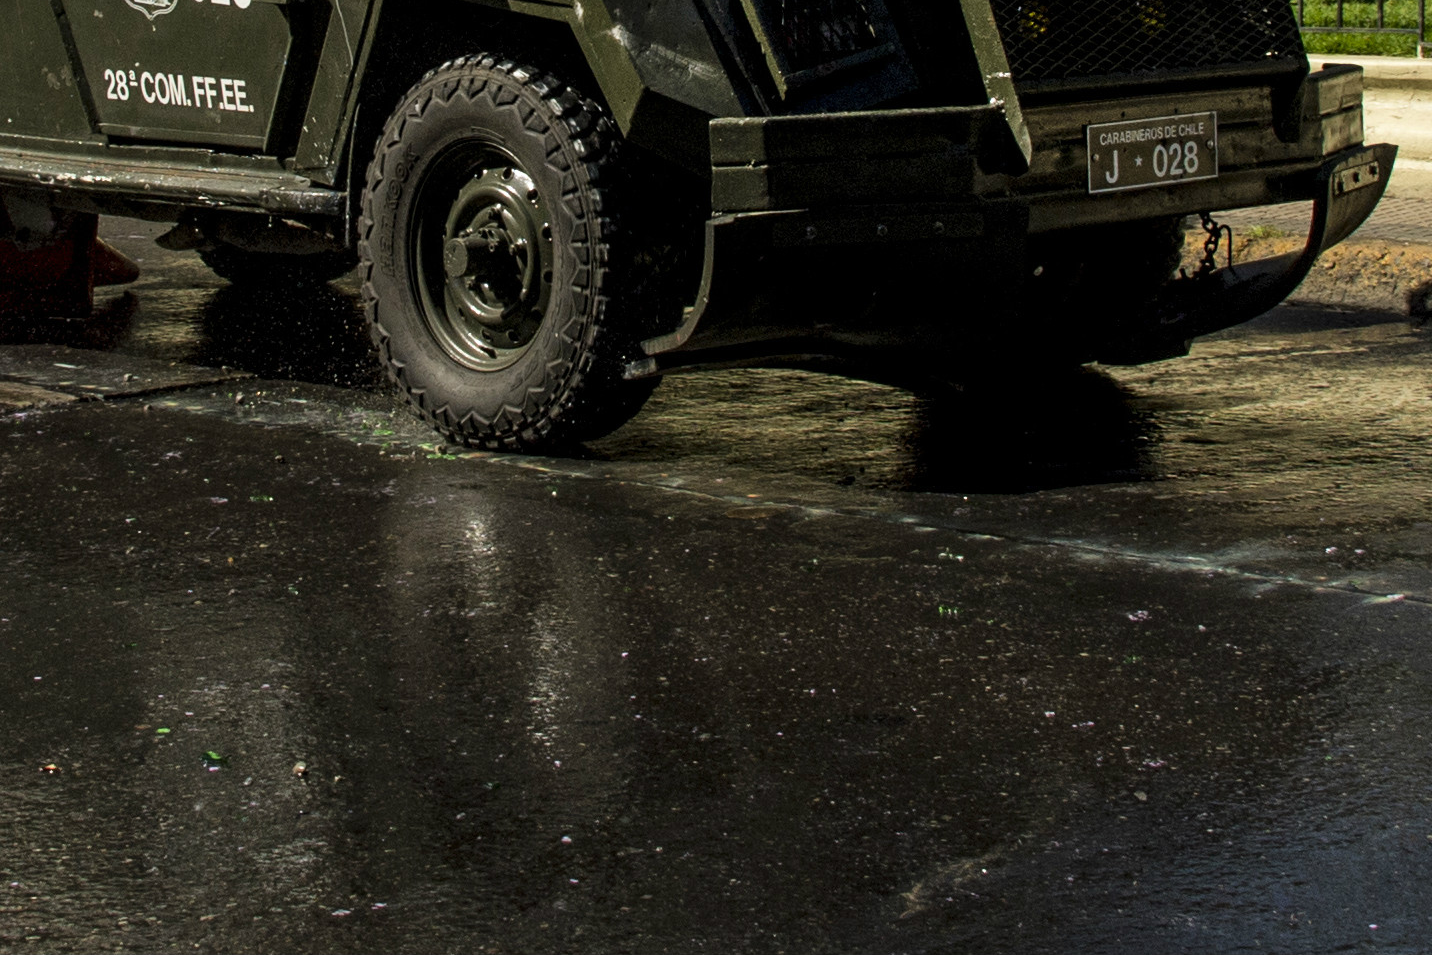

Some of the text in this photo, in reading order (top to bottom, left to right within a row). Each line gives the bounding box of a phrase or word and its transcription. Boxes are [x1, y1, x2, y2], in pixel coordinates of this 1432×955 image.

[1100, 122, 1205, 146] CARABINEROS DE CHILE
[1105, 141, 1199, 184] J 028
